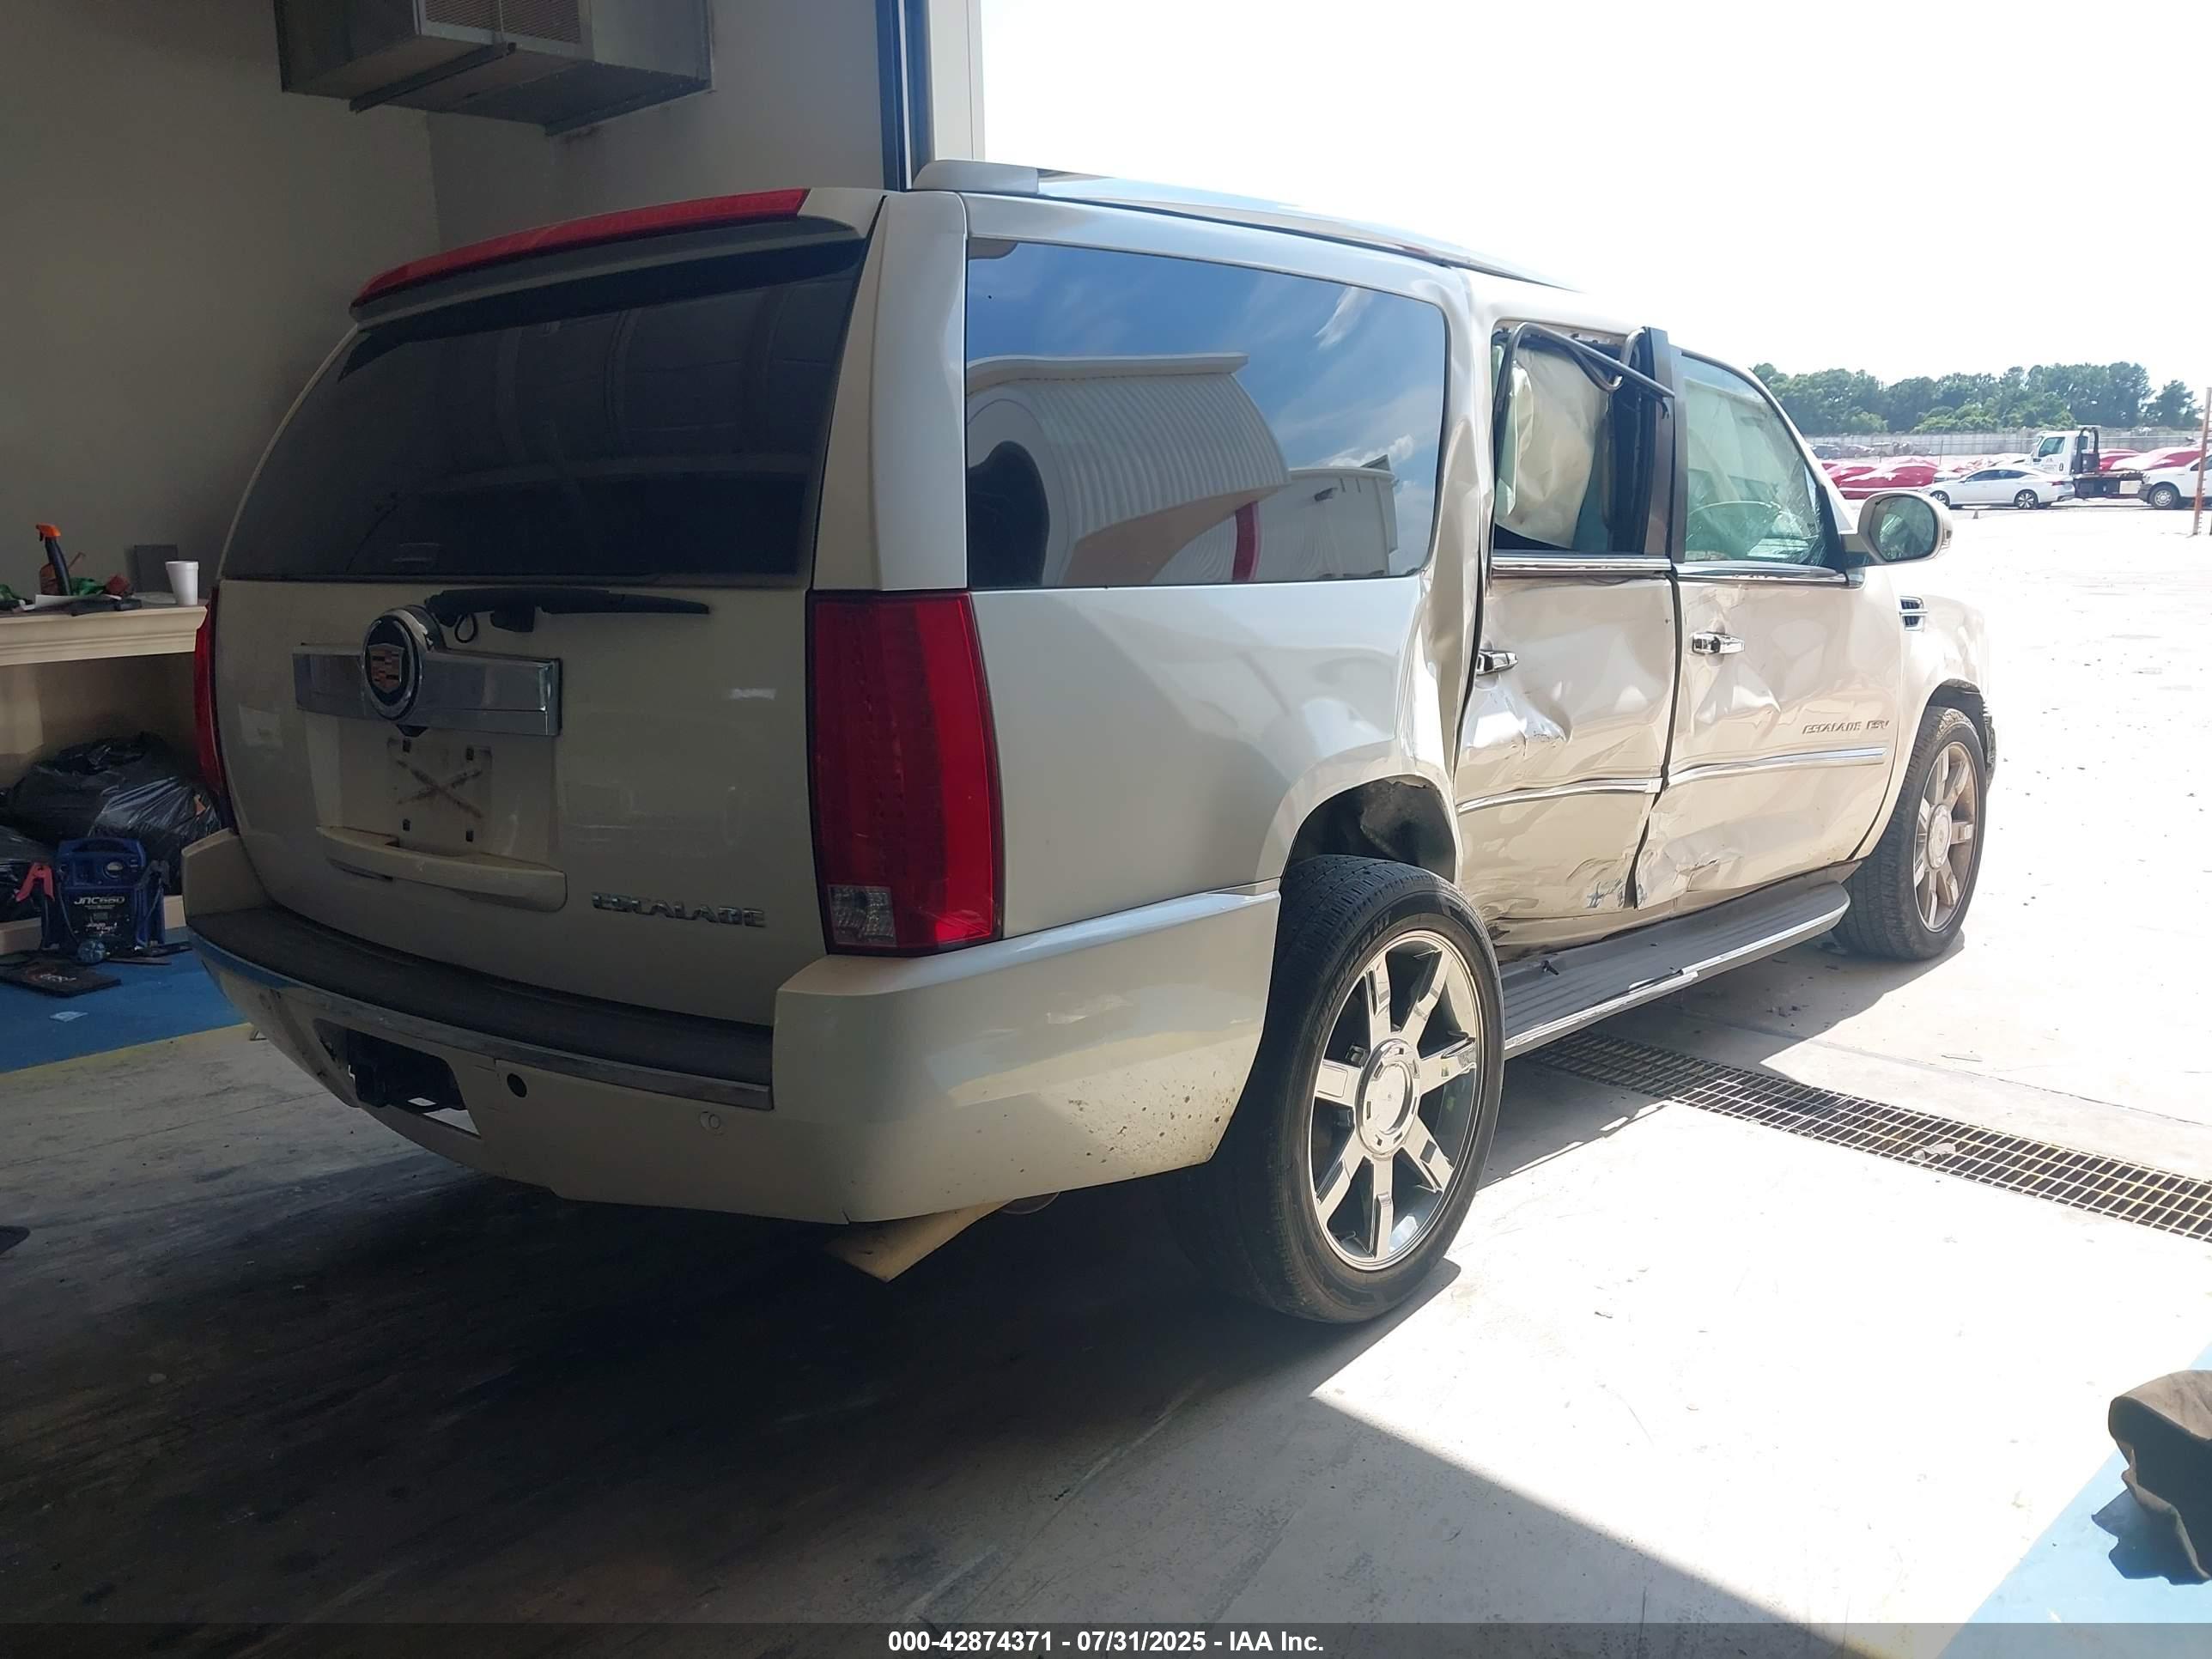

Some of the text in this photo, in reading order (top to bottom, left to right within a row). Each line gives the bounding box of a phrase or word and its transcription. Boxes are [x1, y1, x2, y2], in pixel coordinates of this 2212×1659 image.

[1802, 720, 1890, 734] ESCALADE ESV
[591, 890, 768, 928] ESCALADE
